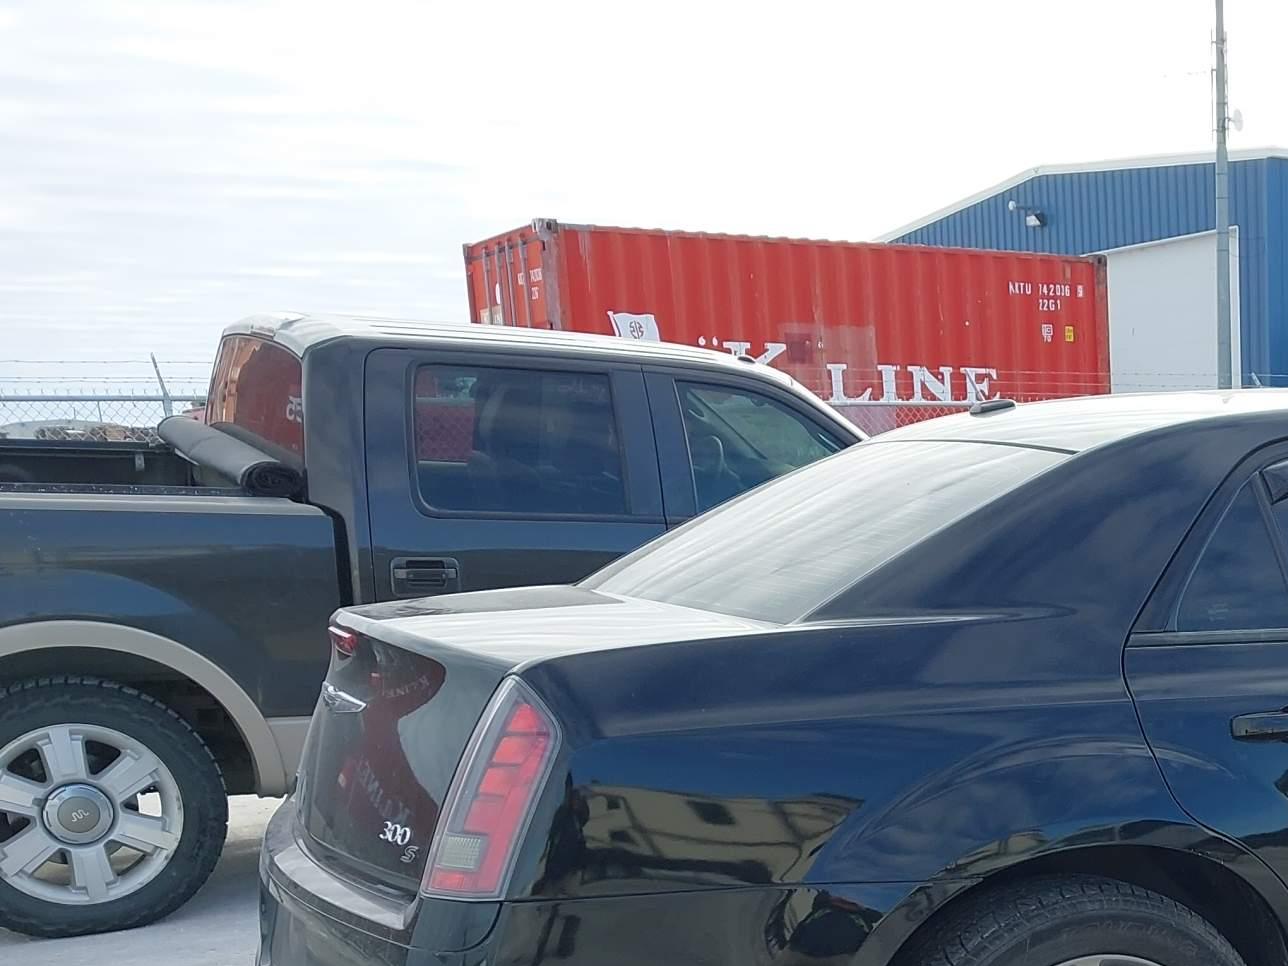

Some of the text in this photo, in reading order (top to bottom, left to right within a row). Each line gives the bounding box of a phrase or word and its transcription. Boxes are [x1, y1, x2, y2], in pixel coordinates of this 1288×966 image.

[826, 362, 1000, 403] LINE
[379, 821, 411, 846] 300
[400, 845, 420, 863] S
